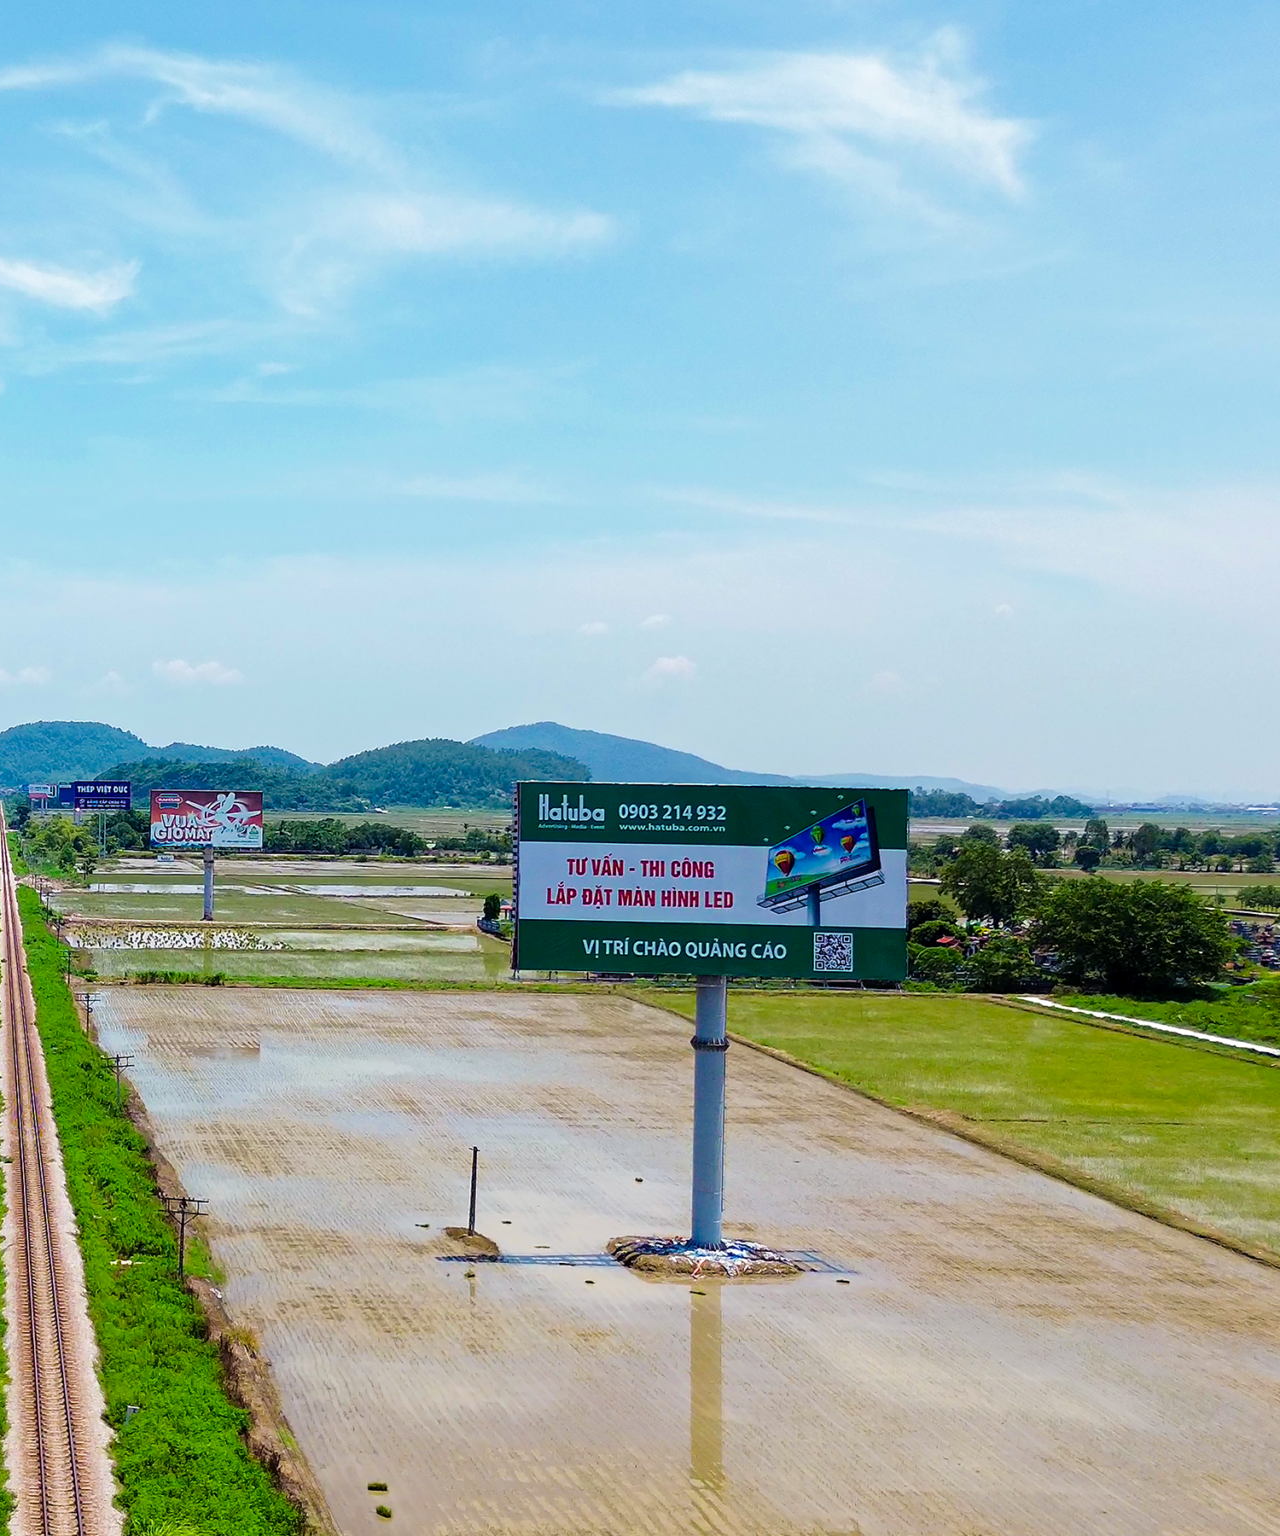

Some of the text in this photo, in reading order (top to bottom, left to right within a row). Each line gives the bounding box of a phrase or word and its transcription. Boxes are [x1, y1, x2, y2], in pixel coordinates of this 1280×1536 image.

[538, 794, 605, 821] Hatuba
[618, 803, 727, 821] 0903 214 932
[161, 813, 198, 828] VUA
[619, 822, 726, 832] www.hatuba.com.vn
[567, 856, 589, 876] TƯ
[591, 853, 624, 876] VẤN
[640, 860, 666, 878] THI
[670, 857, 715, 879] CÔNG
[546, 881, 734, 910] LẮP ĐẶT MÀN HÌNH LED
[582, 937, 787, 960] VỊ TRÍ CHÀO QUẢNG CÁO
